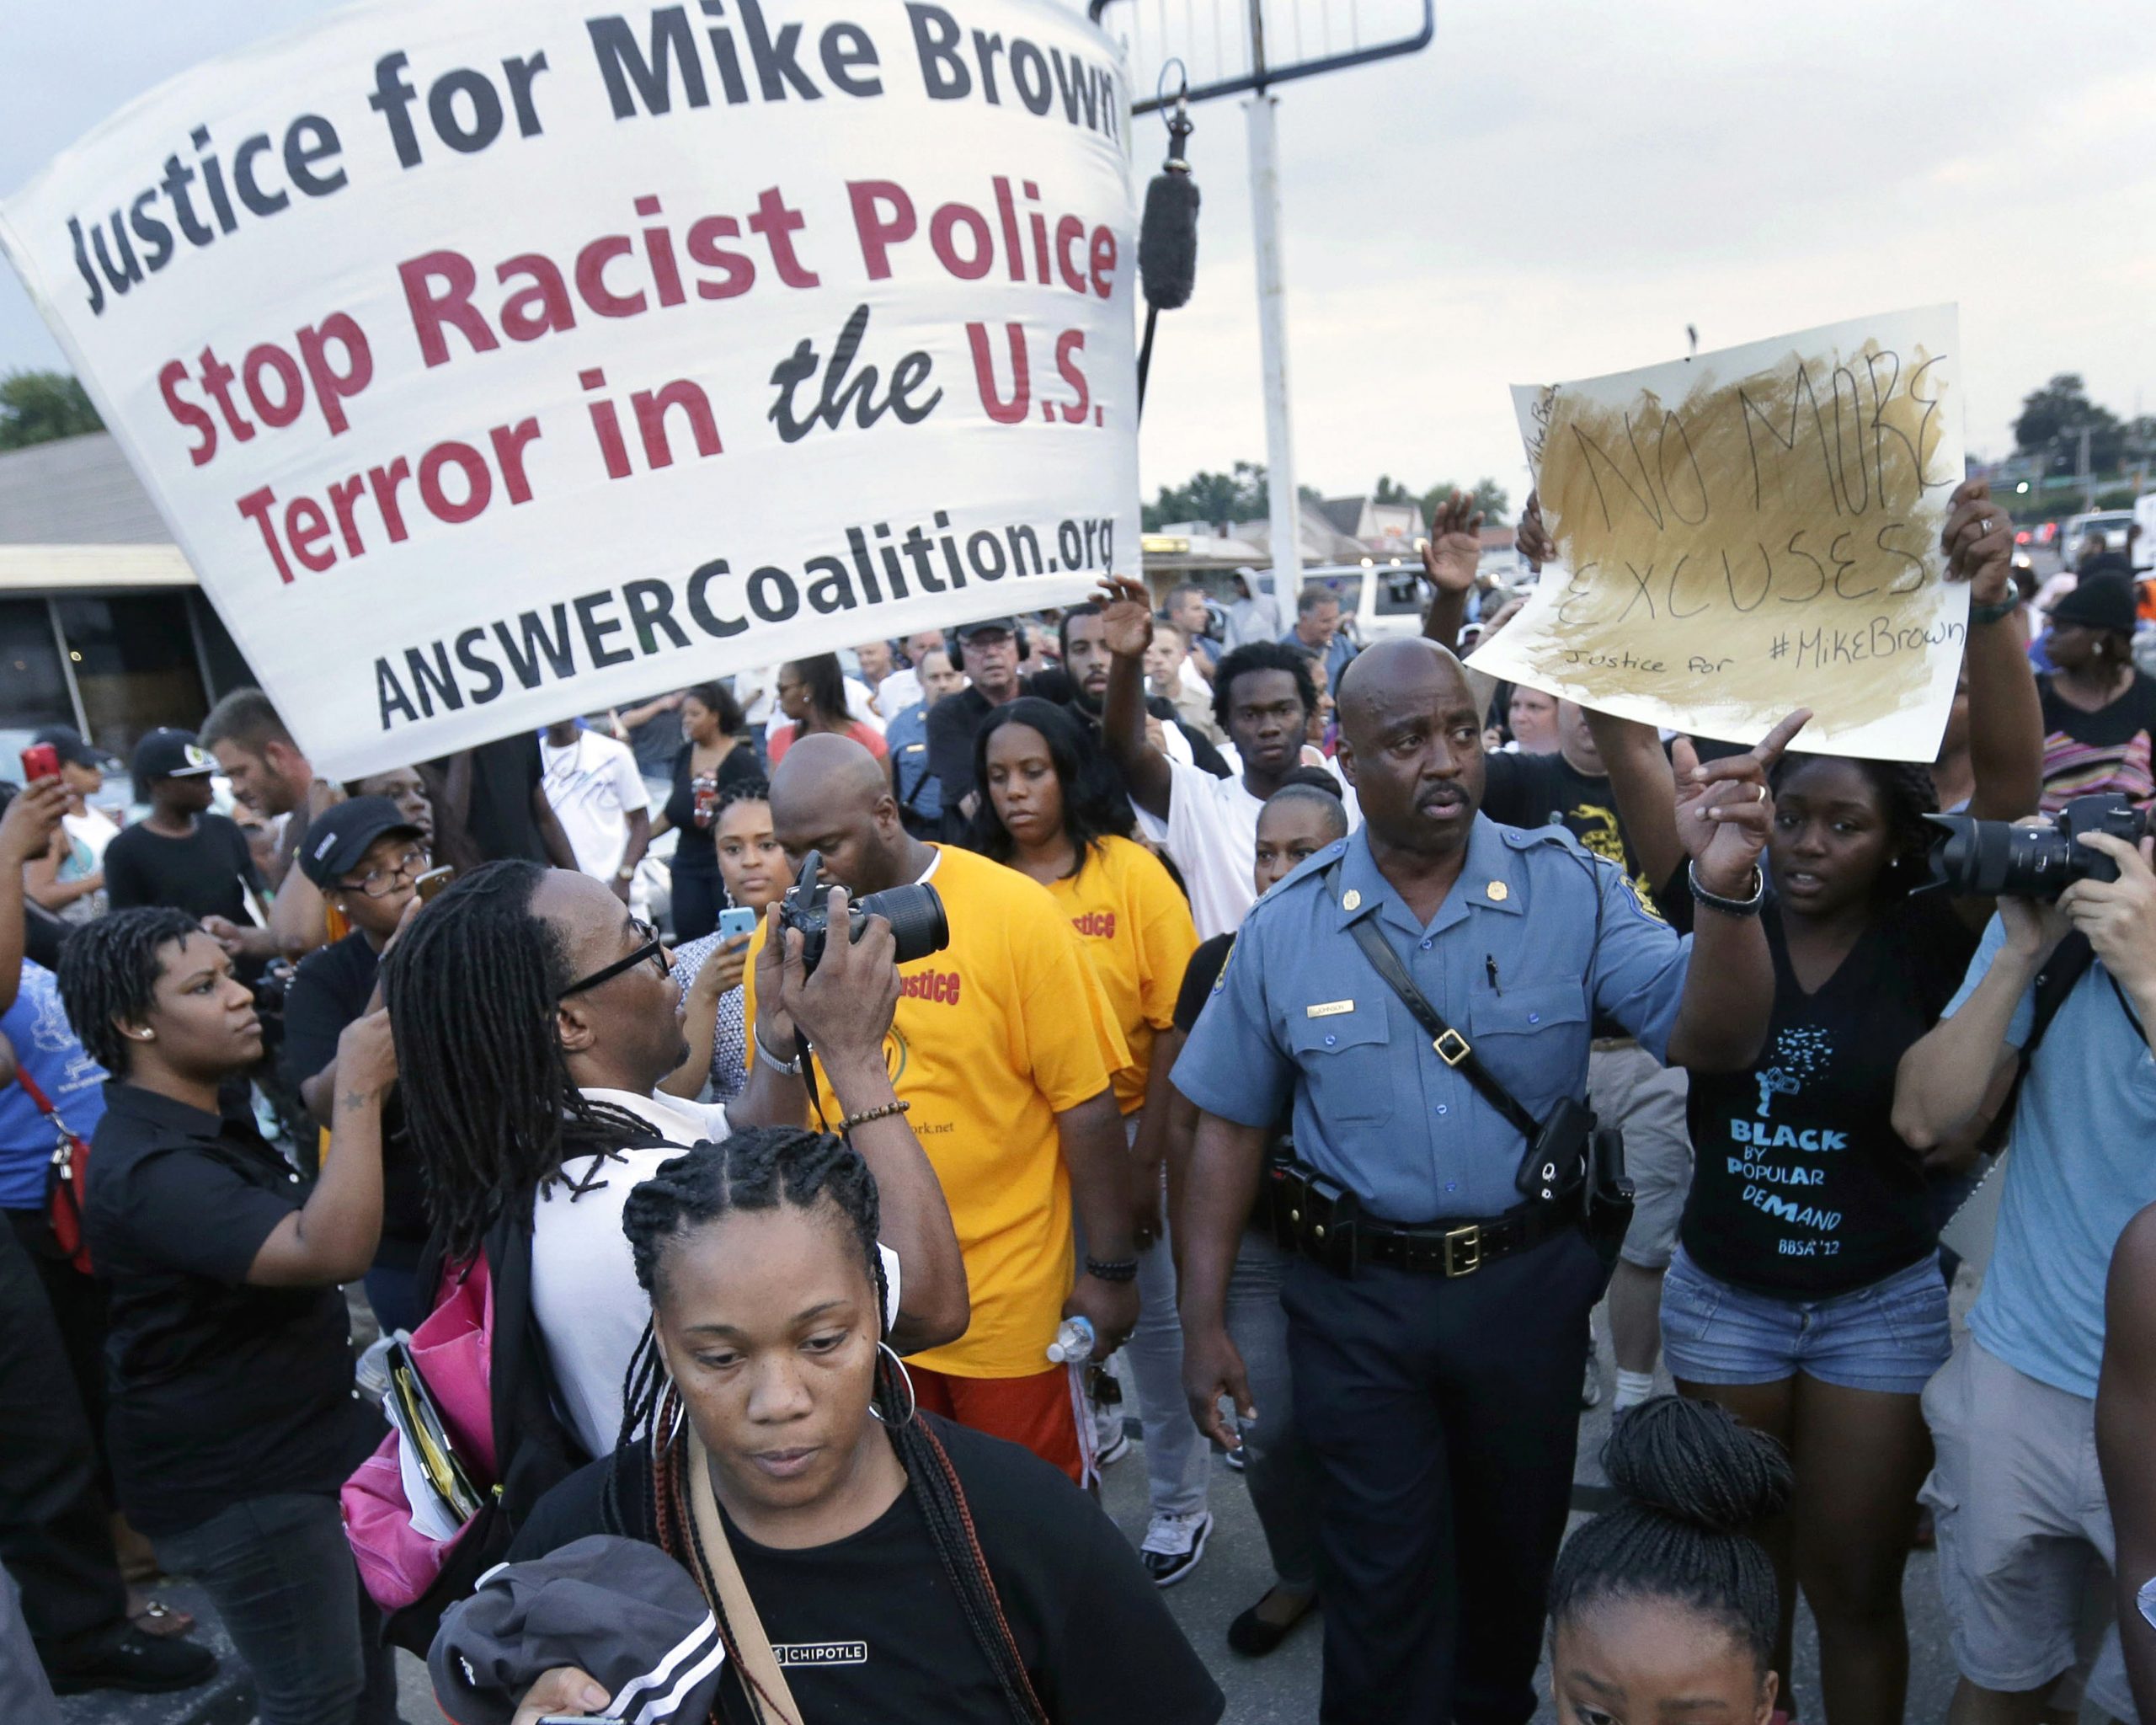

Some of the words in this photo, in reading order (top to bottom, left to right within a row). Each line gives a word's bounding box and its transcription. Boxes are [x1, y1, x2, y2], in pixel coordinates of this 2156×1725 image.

[67, 114, 349, 317] Justice
[368, 50, 549, 169] for
[585, 0, 883, 120] Mike
[905, 3, 1120, 145] Brown
[157, 312, 373, 467] Stop
[398, 186, 820, 368] Racist
[846, 176, 1118, 301] Police
[236, 416, 542, 585] Terror
[578, 367, 723, 479] in
[767, 303, 943, 444] the
[965, 322, 1104, 428] U.S.
[1571, 409, 1709, 532] NO
[1737, 350, 1956, 517] MORE
[1558, 523, 1926, 625] EXCUSES
[375, 510, 1114, 731] ANSWERCoalition.org
[1565, 649, 1667, 673] Justice
[900, 969, 960, 1006] ustice
[1730, 1118, 1849, 1152] BLACK
[1744, 1145, 1767, 1163] BY
[1726, 1156, 1825, 1186] POPULAR
[1742, 1183, 1842, 1231] DEMAND
[790, 1646, 862, 1661] CHIPOTLE
